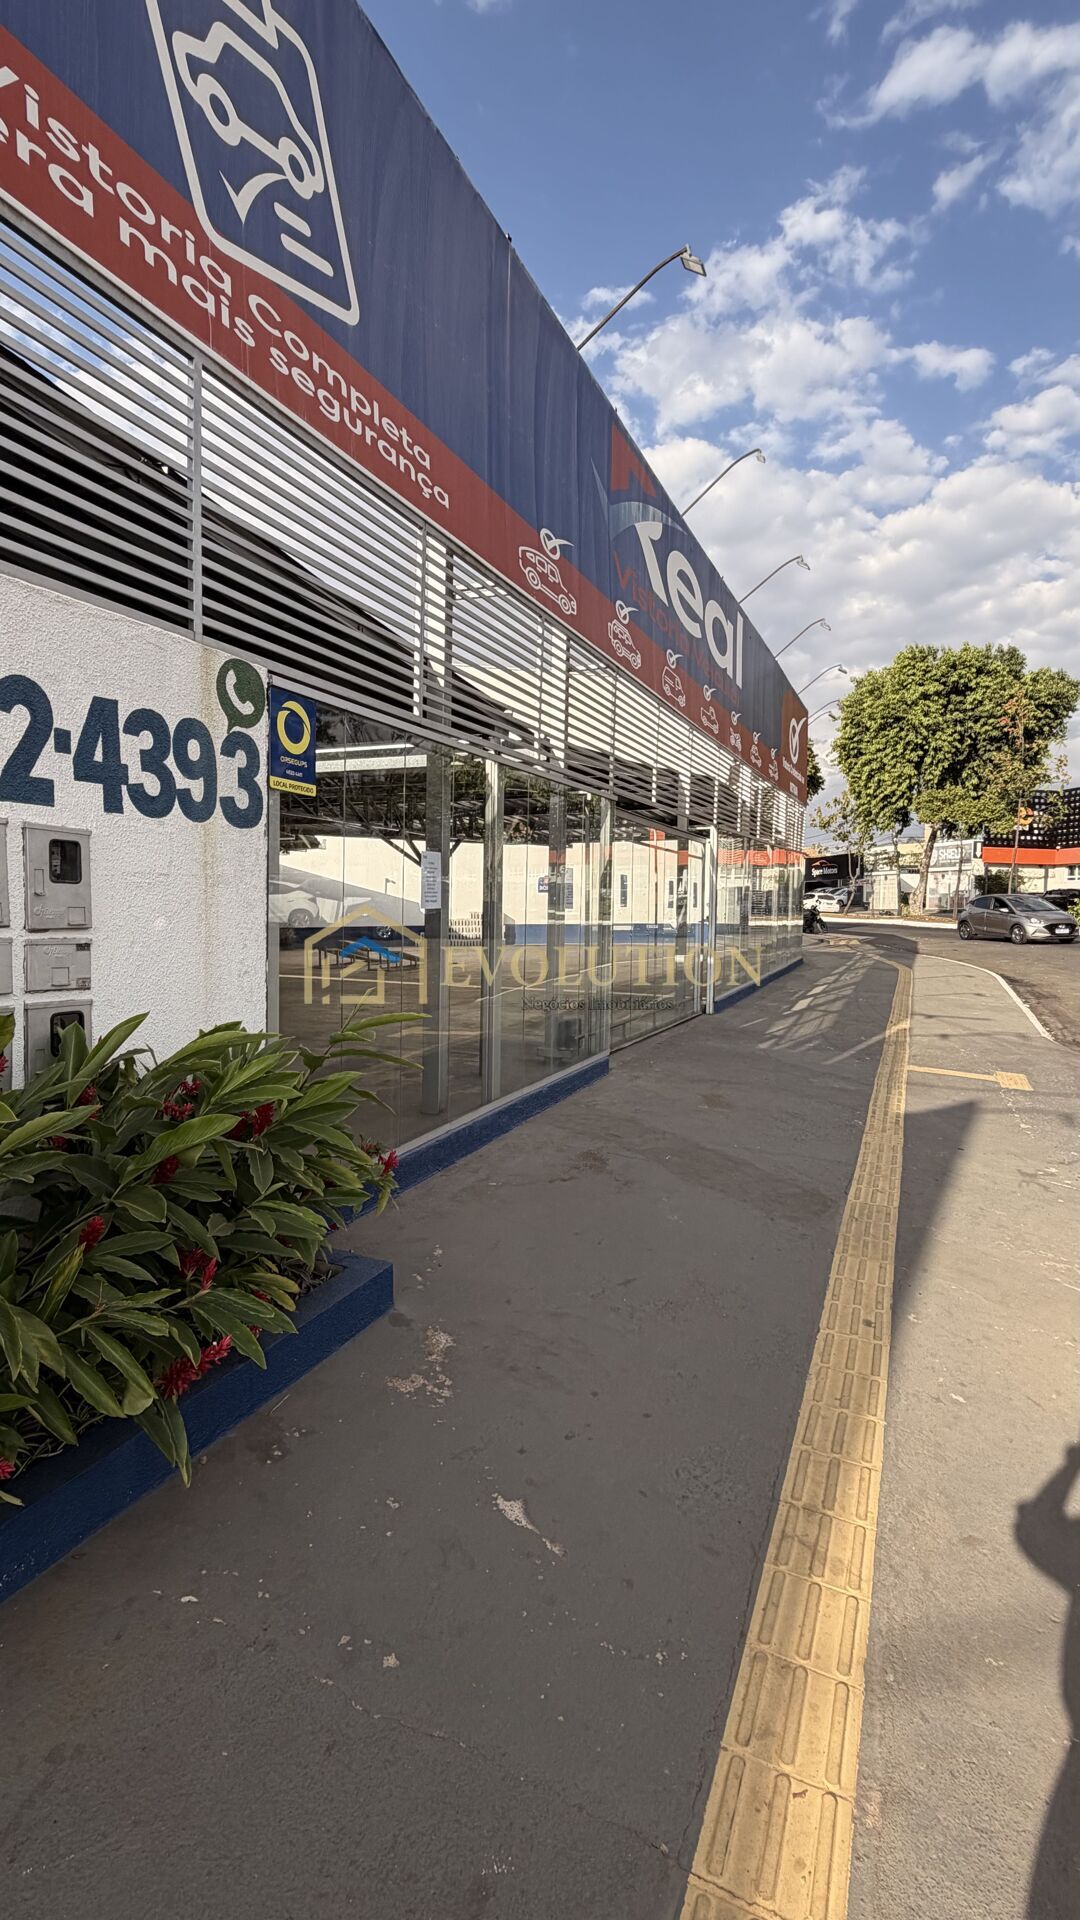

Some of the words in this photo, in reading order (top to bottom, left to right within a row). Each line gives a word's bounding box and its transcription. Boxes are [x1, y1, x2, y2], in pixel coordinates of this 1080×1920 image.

[0, 118, 94, 218] ra
[119, 216, 256, 348] mais
[269, 345, 450, 510] segurança
[248, 294, 431, 471] Completa
[273, 780, 288, 788] LOCAL
